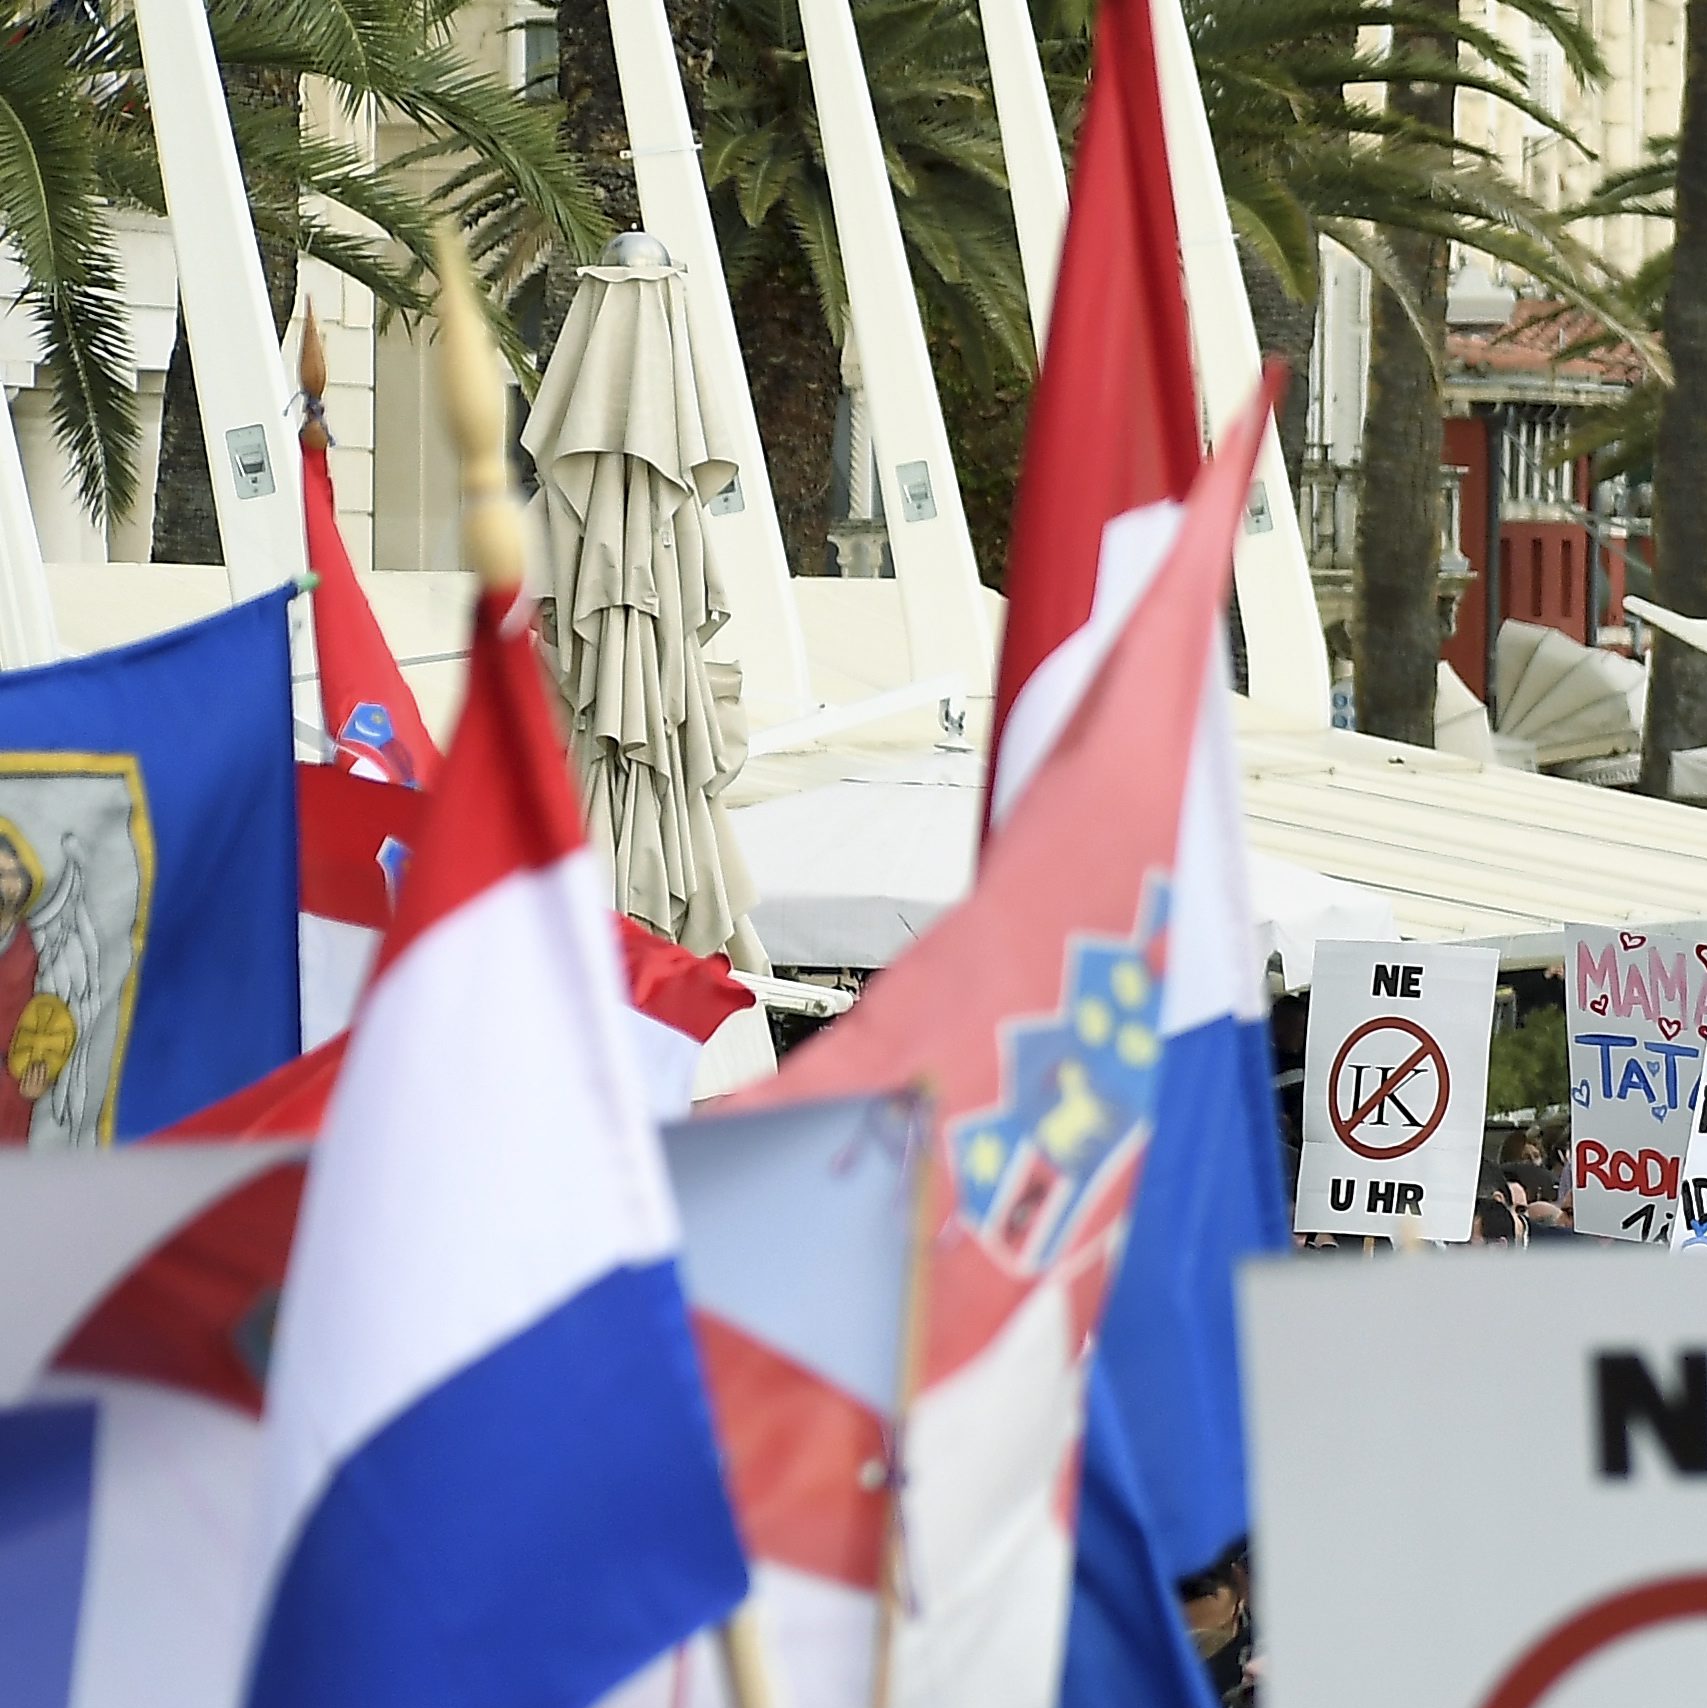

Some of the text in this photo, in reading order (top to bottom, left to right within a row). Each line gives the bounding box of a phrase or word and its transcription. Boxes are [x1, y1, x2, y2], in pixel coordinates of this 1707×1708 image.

[1372, 964, 1424, 998] NE
[1331, 1178, 1424, 1216] U HR
